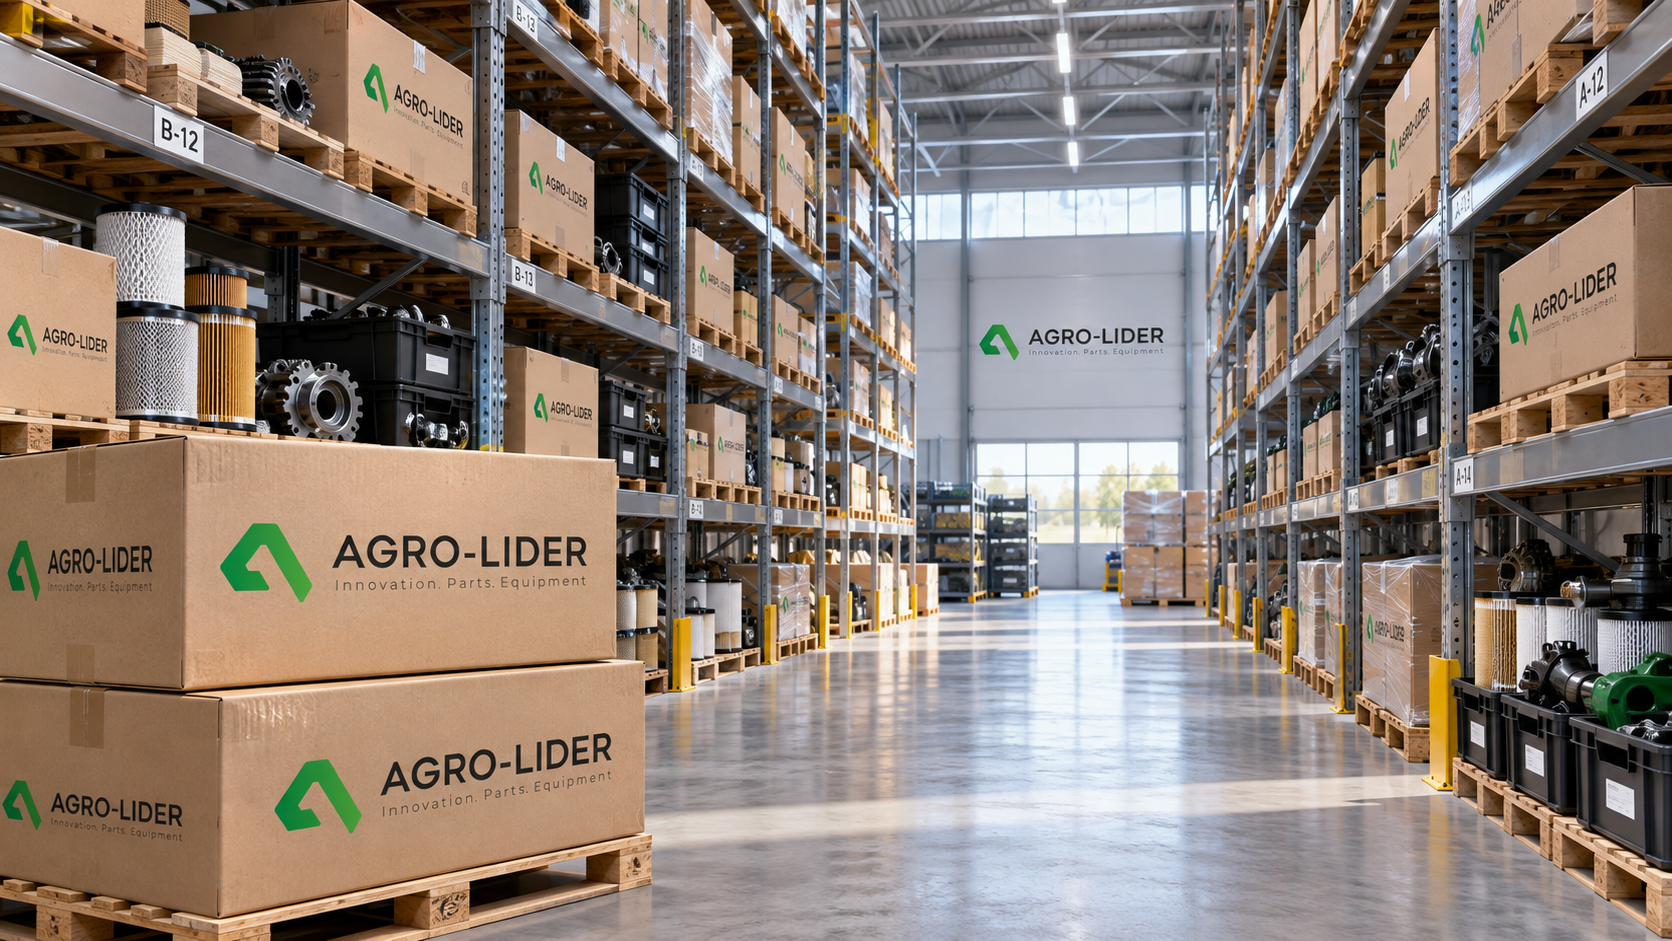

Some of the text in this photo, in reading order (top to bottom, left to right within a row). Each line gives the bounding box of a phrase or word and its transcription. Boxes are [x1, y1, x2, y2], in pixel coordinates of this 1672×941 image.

[516, 5, 535, 33] B-13
[1579, 66, 1604, 109] A-12
[394, 84, 464, 138] AGRO-LIDER
[162, 117, 199, 153] B-12
[546, 174, 588, 210] AGRO-LIDER
[515, 266, 533, 287] B-13
[1532, 262, 1617, 325] AGRO-LIDER
[42, 327, 108, 353] AGRO-LIDER
[1028, 327, 1164, 345] AGRO-LIDER
[1029, 347, 1164, 356] Innovation. Parts. Equipment
[1456, 465, 1471, 486] A-14
[47, 545, 153, 574] AGRO-LIDER
[332, 534, 587, 569] AGRO-LIDER
[110, 580, 153, 594] Equipment
[335, 575, 587, 591] Innovation. Parts. Equipment
[380, 732, 612, 796] AGRO-LIDER
[382, 770, 612, 818] Innovation. Parts. Equipment
[50, 792, 183, 827] AGRO-LIDER
[50, 817, 98, 832] Innovation.
[131, 827, 183, 842] Equipment
